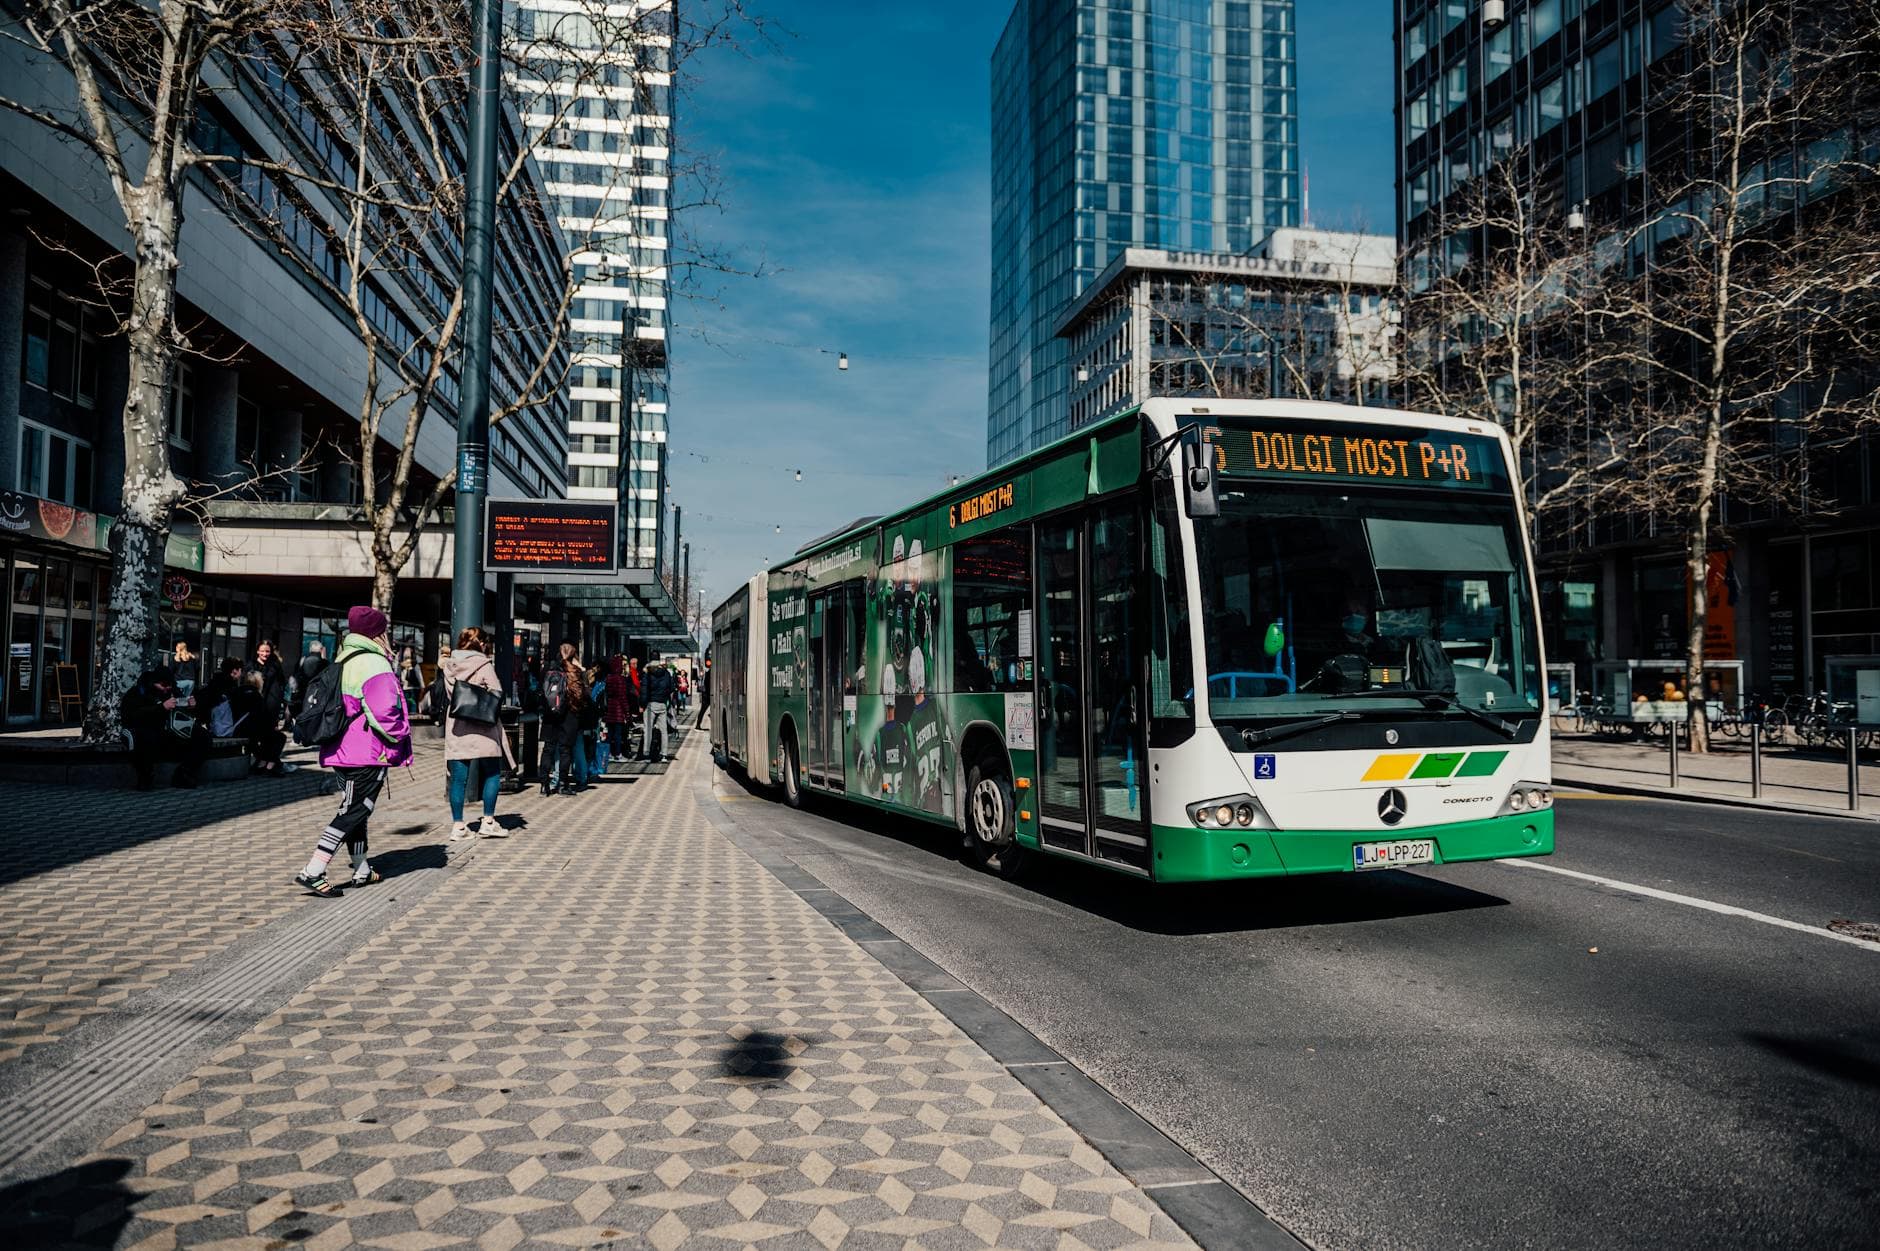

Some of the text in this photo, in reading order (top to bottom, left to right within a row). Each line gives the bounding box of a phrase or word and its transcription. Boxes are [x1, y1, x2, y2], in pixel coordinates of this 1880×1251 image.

[1252, 431, 1337, 473] DOLGI
[1344, 437, 1409, 477] MOST
[1419, 442, 1471, 481] P+R
[949, 482, 1013, 529] 6 DOLGI MOST P+R
[772, 595, 806, 622] Se vidimo
[777, 630, 792, 654] Hali
[1442, 795, 1494, 805] CONECTO
[1363, 846, 1379, 863] LJ
